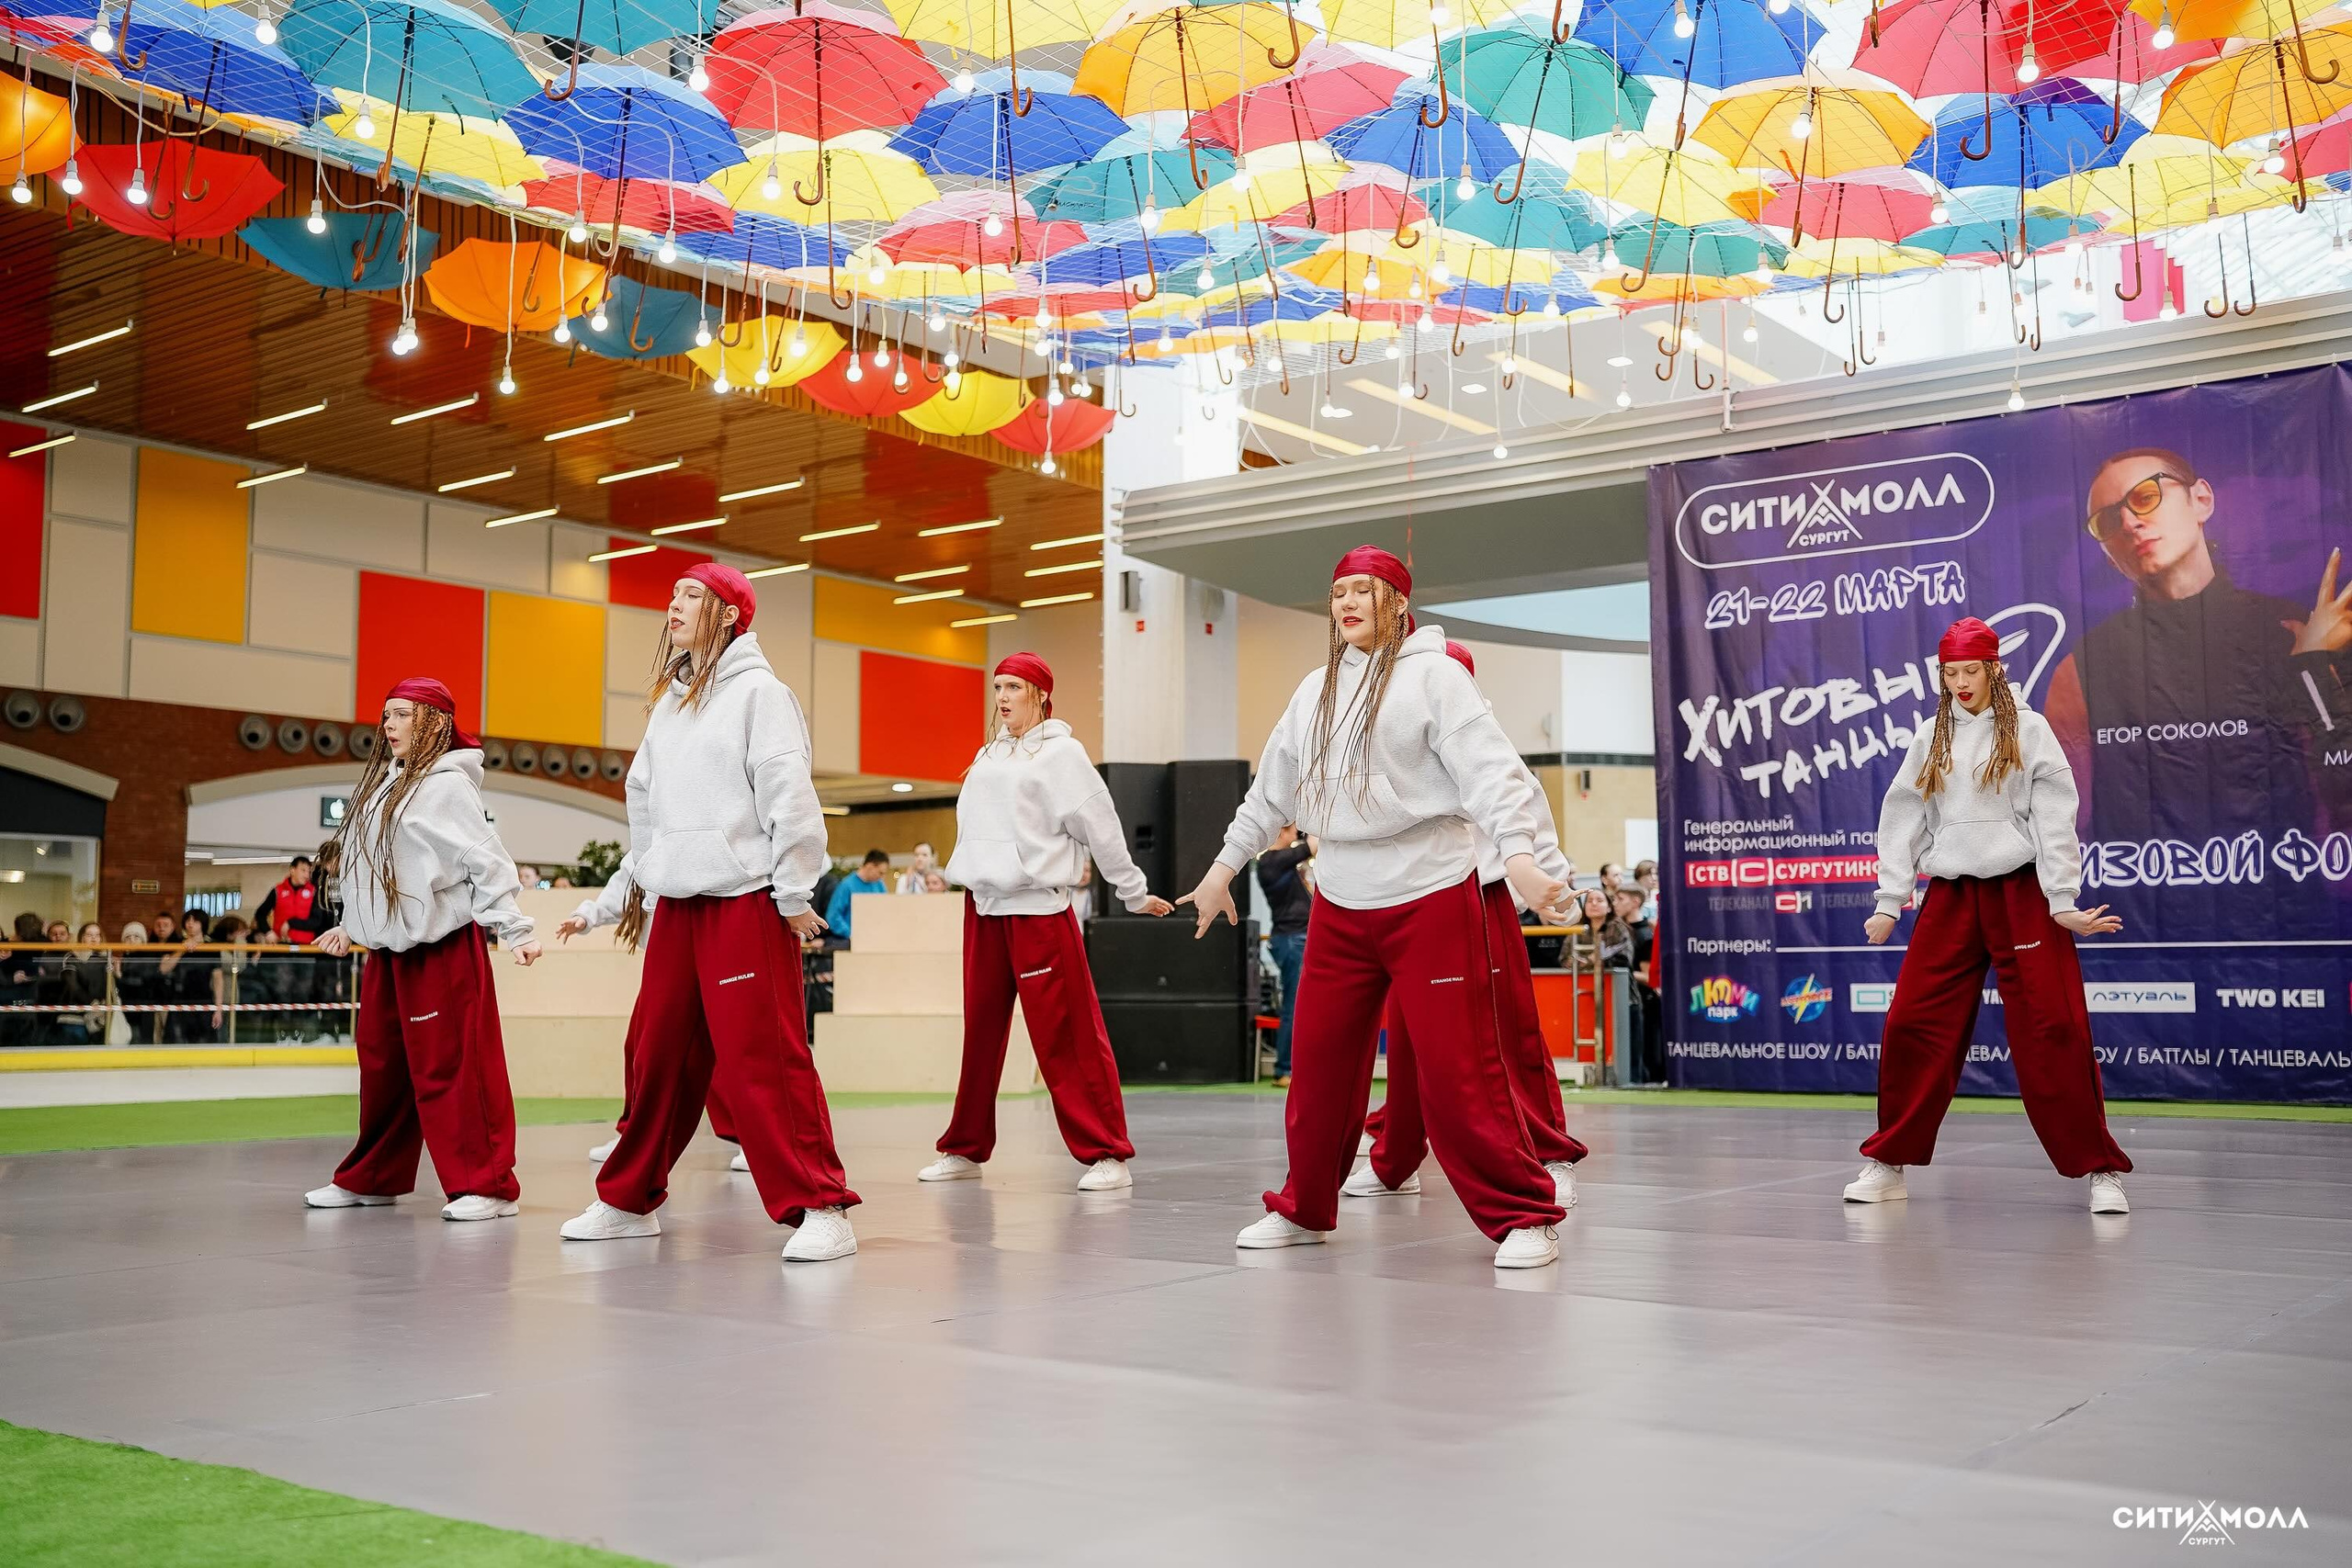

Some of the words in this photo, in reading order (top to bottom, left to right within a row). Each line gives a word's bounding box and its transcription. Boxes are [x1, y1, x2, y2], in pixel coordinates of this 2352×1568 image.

[1797, 528, 1850, 547] СУРГУТ
[1703, 580, 1828, 630] 21-22
[1834, 559, 1966, 616] МАРТА
[2097, 726, 2143, 745] ЕГОР
[2146, 718, 2249, 743] СОКОЛОВ
[2324, 749, 2352, 766] МИ
[1684, 814, 1794, 838] Генеральный
[1684, 829, 1847, 855] информационный
[1849, 830, 1878, 848] па
[2079, 829, 2265, 889] ИЗОВОЙ
[2271, 828, 2352, 883] ФО
[1709, 895, 1770, 911] ТЕЛЕКАНАЛ
[1820, 891, 1876, 909] ТЕЛЕКАНА
[1687, 937, 1771, 956] Партнеры:
[2215, 988, 2278, 1009] TWO
[2282, 987, 2325, 1009] KEI
[1707, 1006, 1739, 1021] парк
[1667, 1041, 1786, 1060] ТАНЦЕВАЛЬНОЕ
[1788, 1042, 1831, 1060] ШОУ
[1845, 1043, 1882, 1060] БАТТ
[2093, 1045, 2119, 1065] ОУ
[2137, 1047, 2211, 1066] БАТТЛЫ
[2230, 1048, 2352, 1068] ТАНЦЕВАЛЬ
